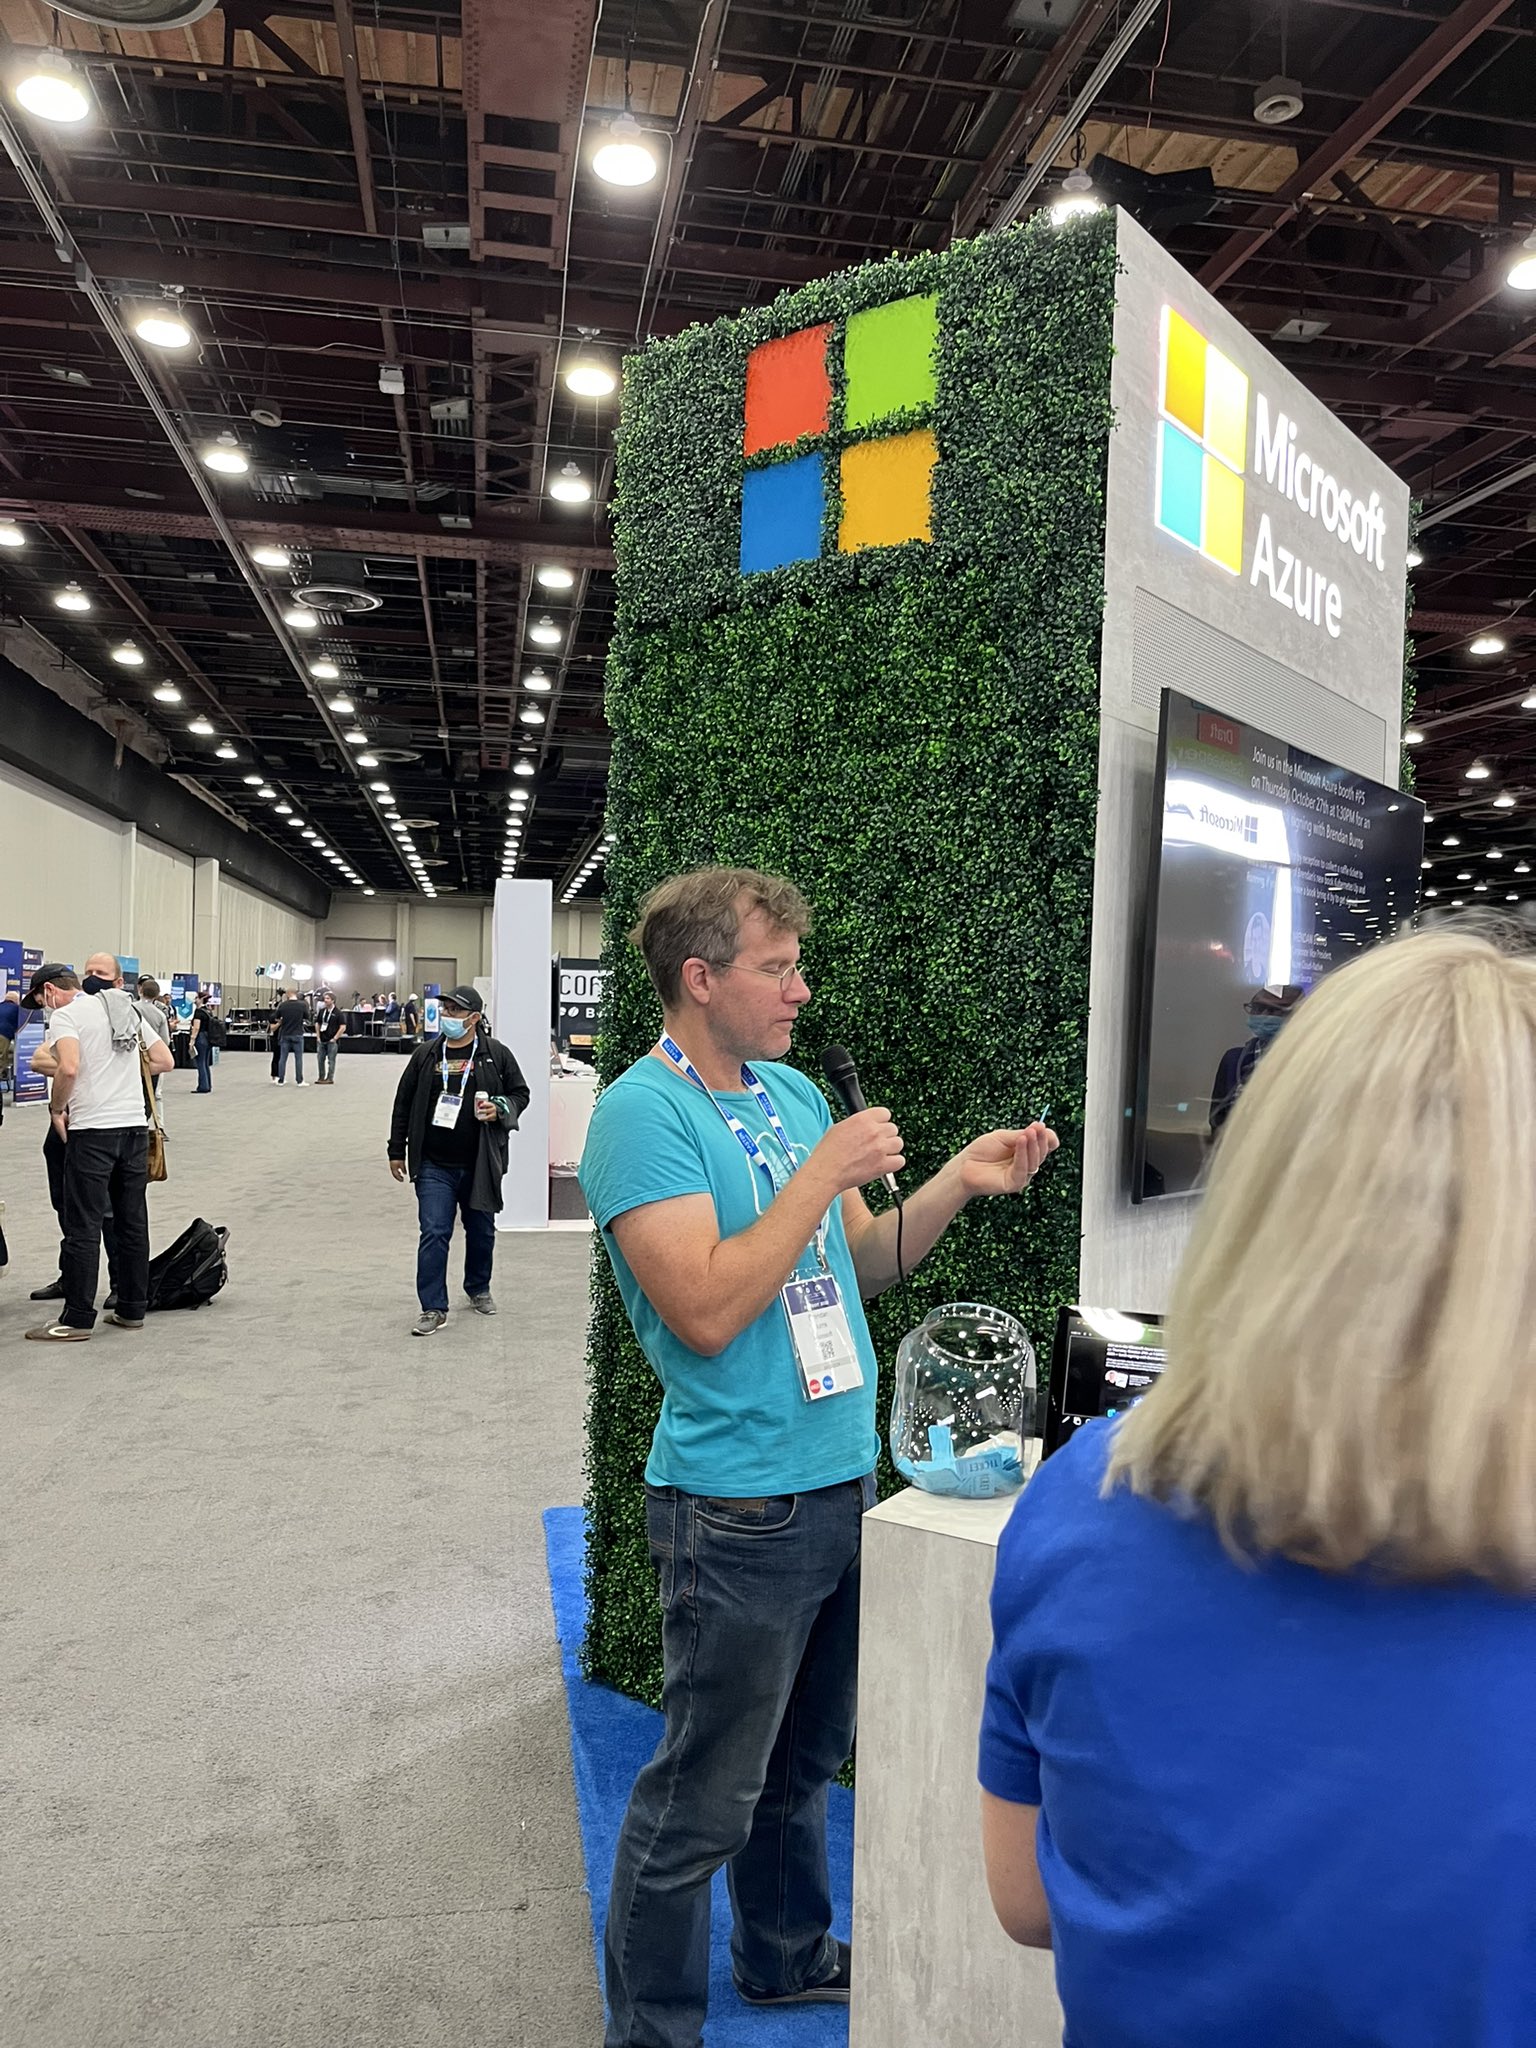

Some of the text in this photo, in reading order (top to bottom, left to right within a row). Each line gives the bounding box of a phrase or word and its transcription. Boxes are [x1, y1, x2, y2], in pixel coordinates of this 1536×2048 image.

[1254, 391, 1386, 572] Microsoft
[1249, 513, 1343, 639] Azure
[1251, 775, 1261, 790] on
[1291, 787, 1316, 810] October
[1329, 804, 1336, 818] at
[1252, 746, 1267, 766] Join
[1267, 755, 1275, 769] us
[1276, 754, 1282, 772] in
[1283, 757, 1293, 777] the
[1294, 763, 1321, 788] Microsoft
[1321, 775, 1338, 795] Azure
[1338, 780, 1355, 801] booth
[1326, 824, 1349, 846] Brendan
[1349, 832, 1364, 850] Burns
[739, 1131, 755, 1154] KASTEN
